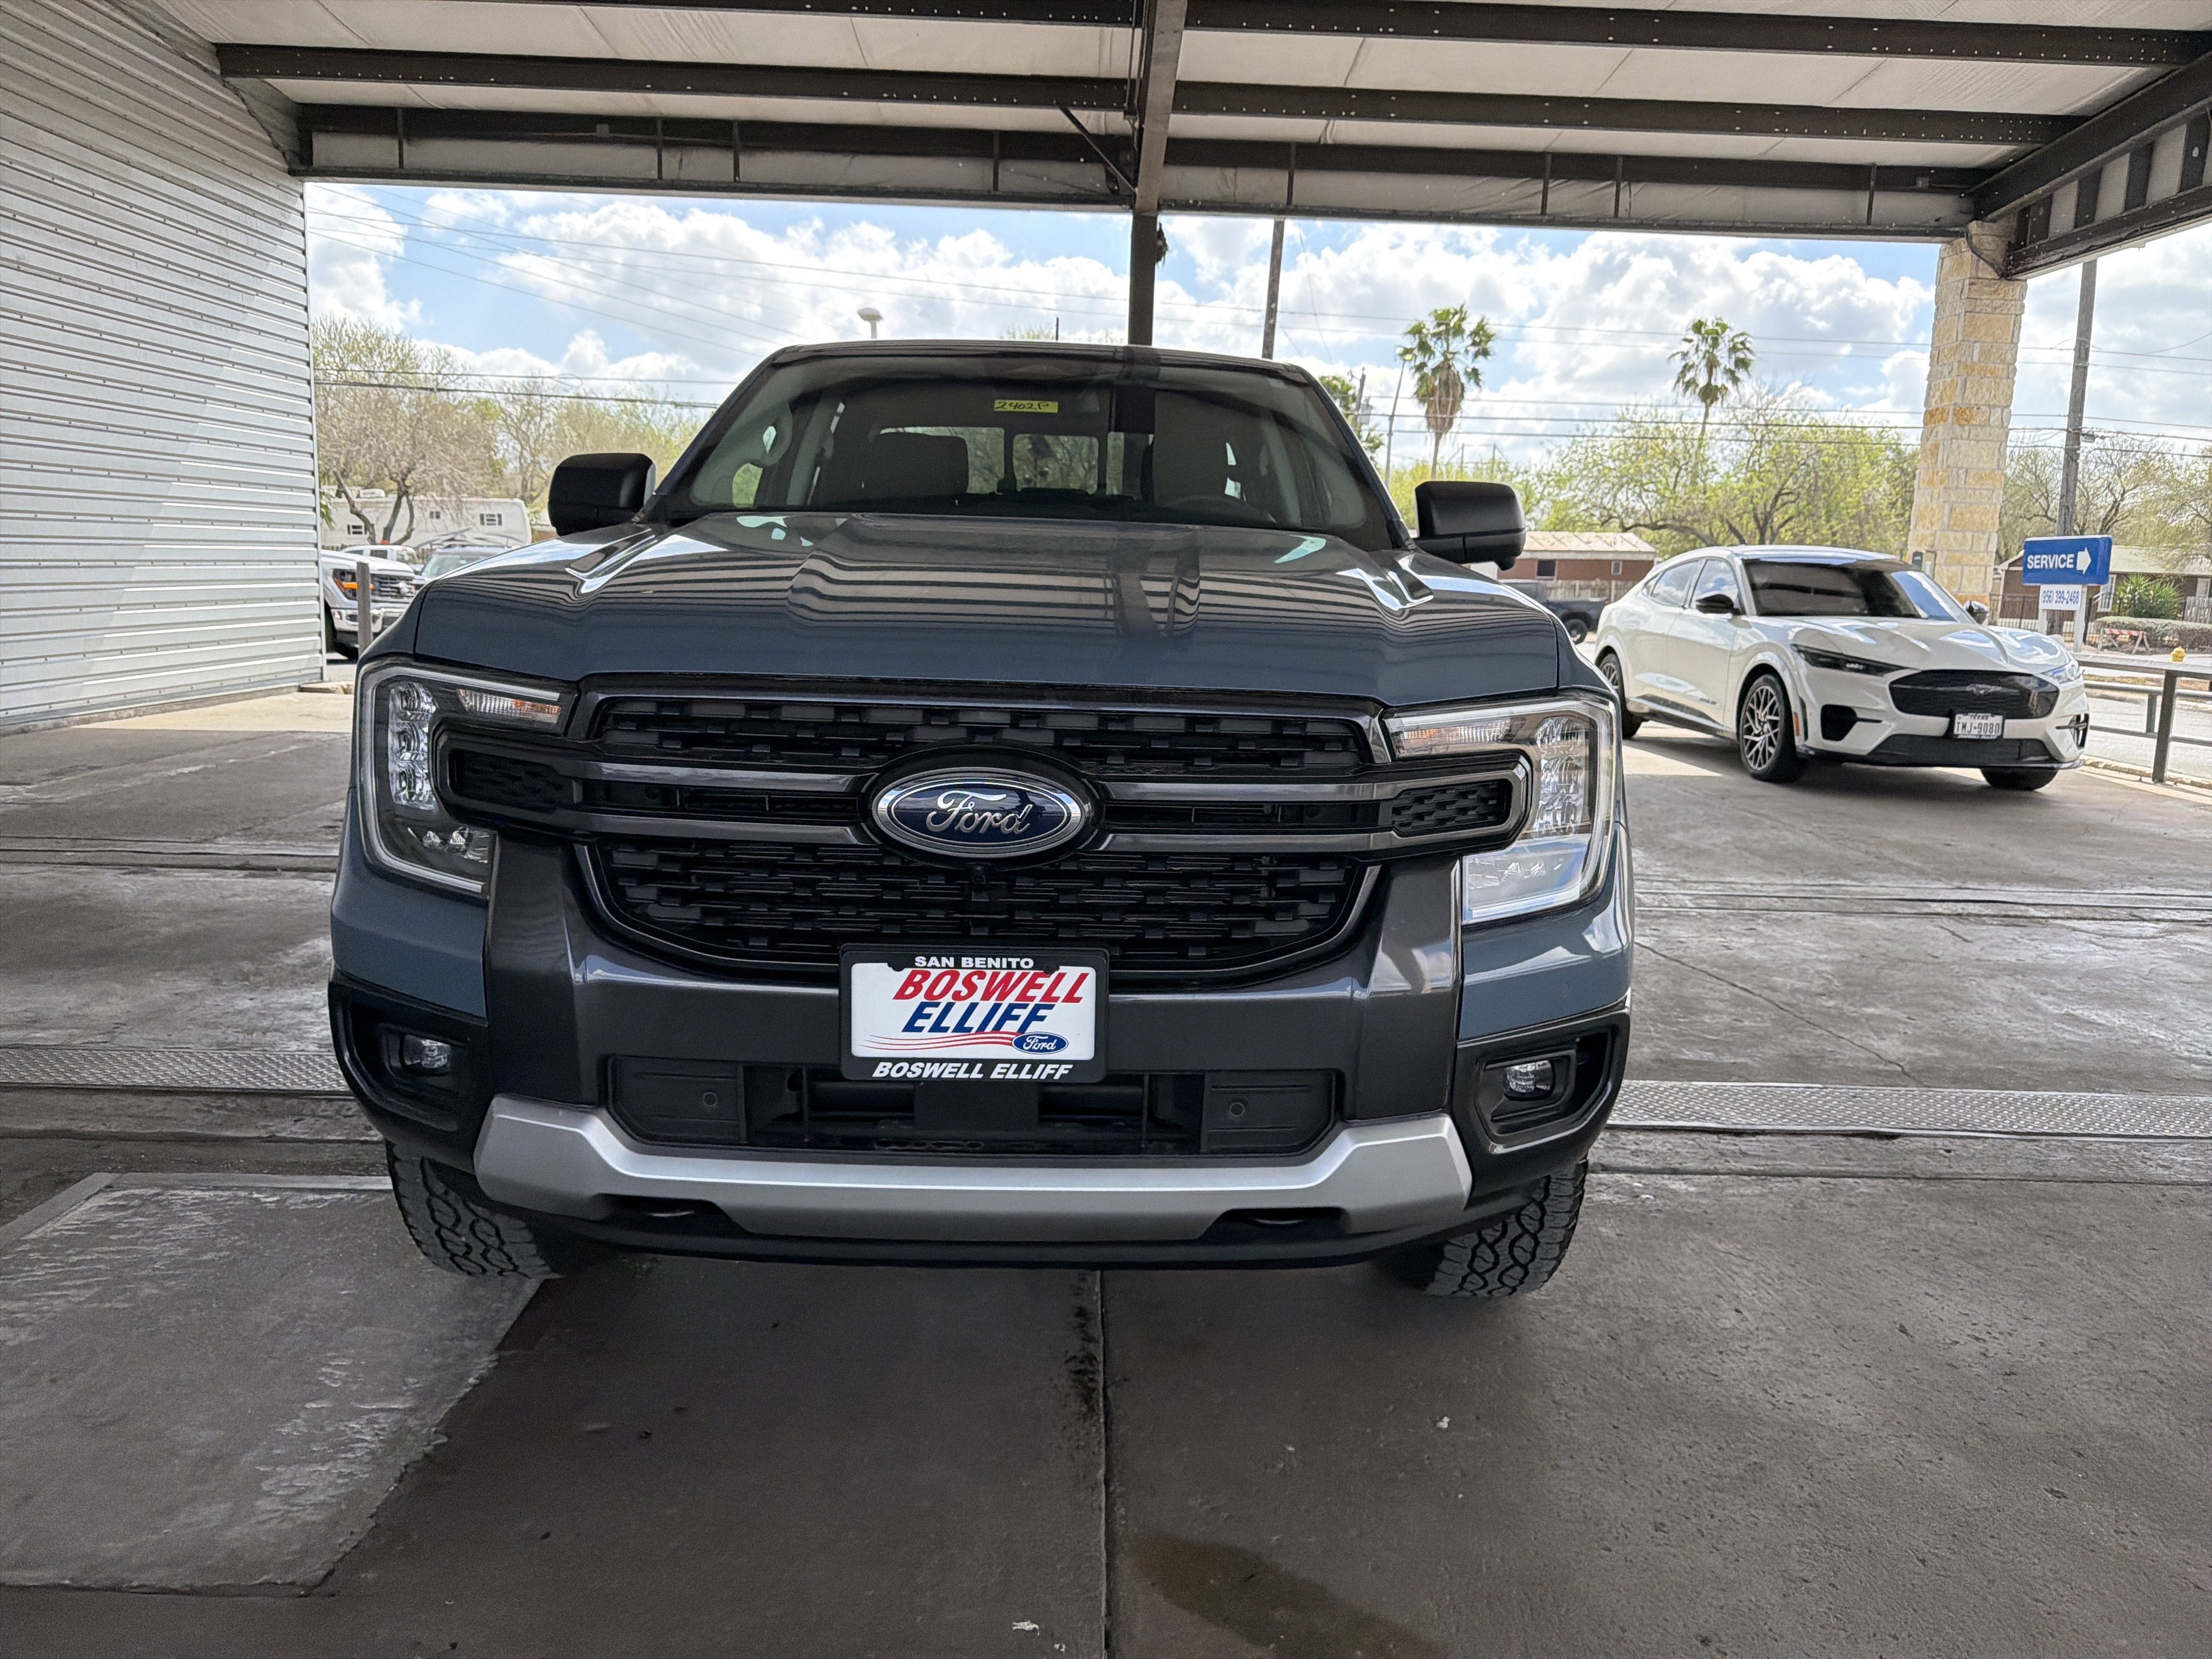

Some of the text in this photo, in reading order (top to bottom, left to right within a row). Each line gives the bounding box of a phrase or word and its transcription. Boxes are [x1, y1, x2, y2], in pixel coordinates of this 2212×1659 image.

[2027, 554, 2075, 569] SERVICE
[2041, 589, 2079, 604] (956) 399-2468
[926, 790, 1033, 834] Ford
[914, 956, 1034, 969] SAN BENITO
[892, 969, 1090, 1003] BOSWELL
[901, 1001, 1056, 1033] ELLIFF
[1023, 1035, 1057, 1050] Ford
[872, 1062, 1074, 1080] BOSWELL ELLIFF
